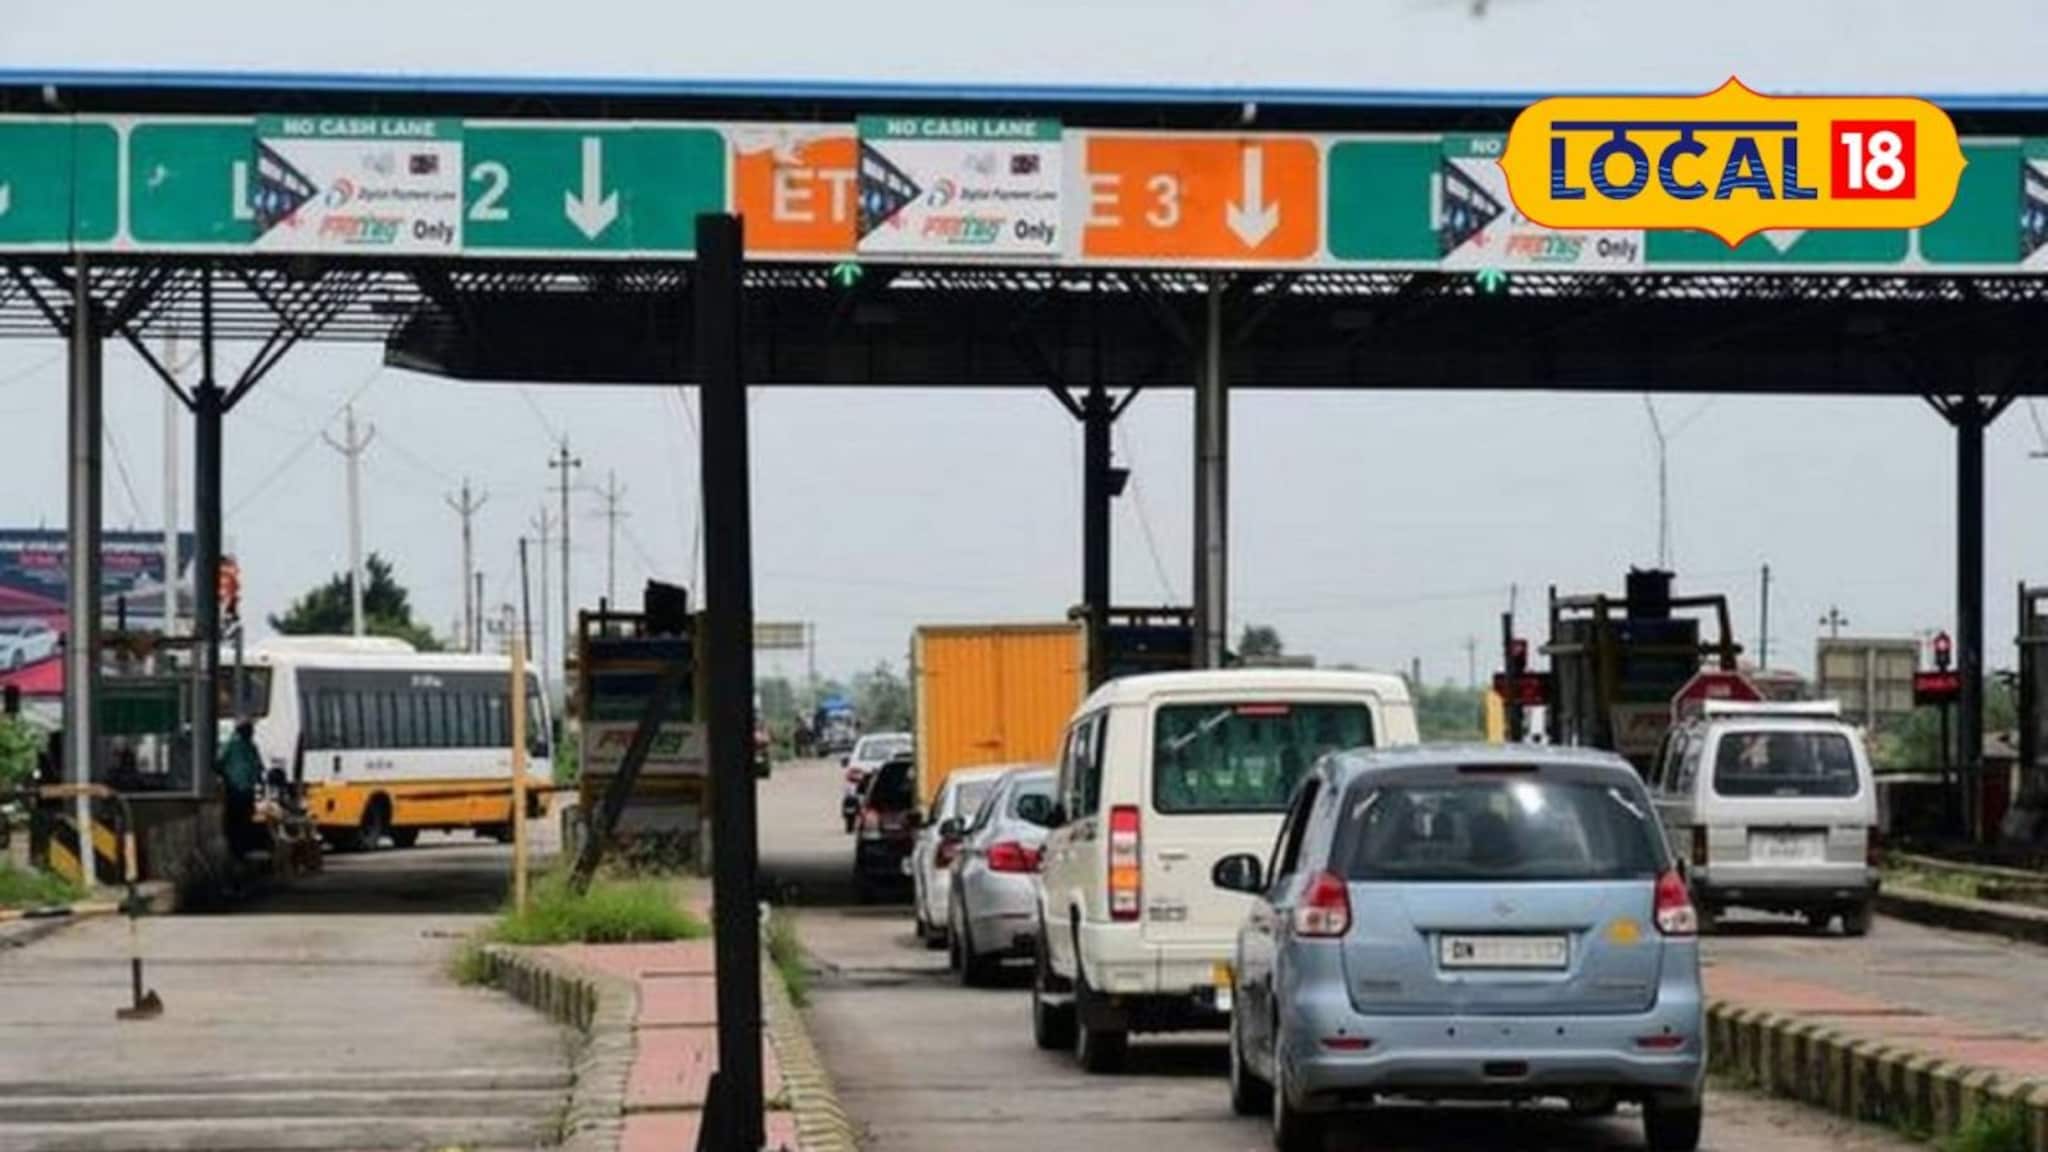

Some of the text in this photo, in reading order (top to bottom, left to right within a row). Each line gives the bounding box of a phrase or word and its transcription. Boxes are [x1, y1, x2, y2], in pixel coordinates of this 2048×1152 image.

[283, 120, 436, 136] NO CASH LANE
[887, 119, 1037, 137] NO CASH LANE
[1471, 139, 1501, 154] NO
[468, 160, 510, 221] 2
[773, 168, 857, 222] ET
[1145, 174, 1180, 228] 3
[413, 219, 455, 244] Only
[1014, 219, 1055, 245] Only
[1596, 238, 1638, 262] Only
